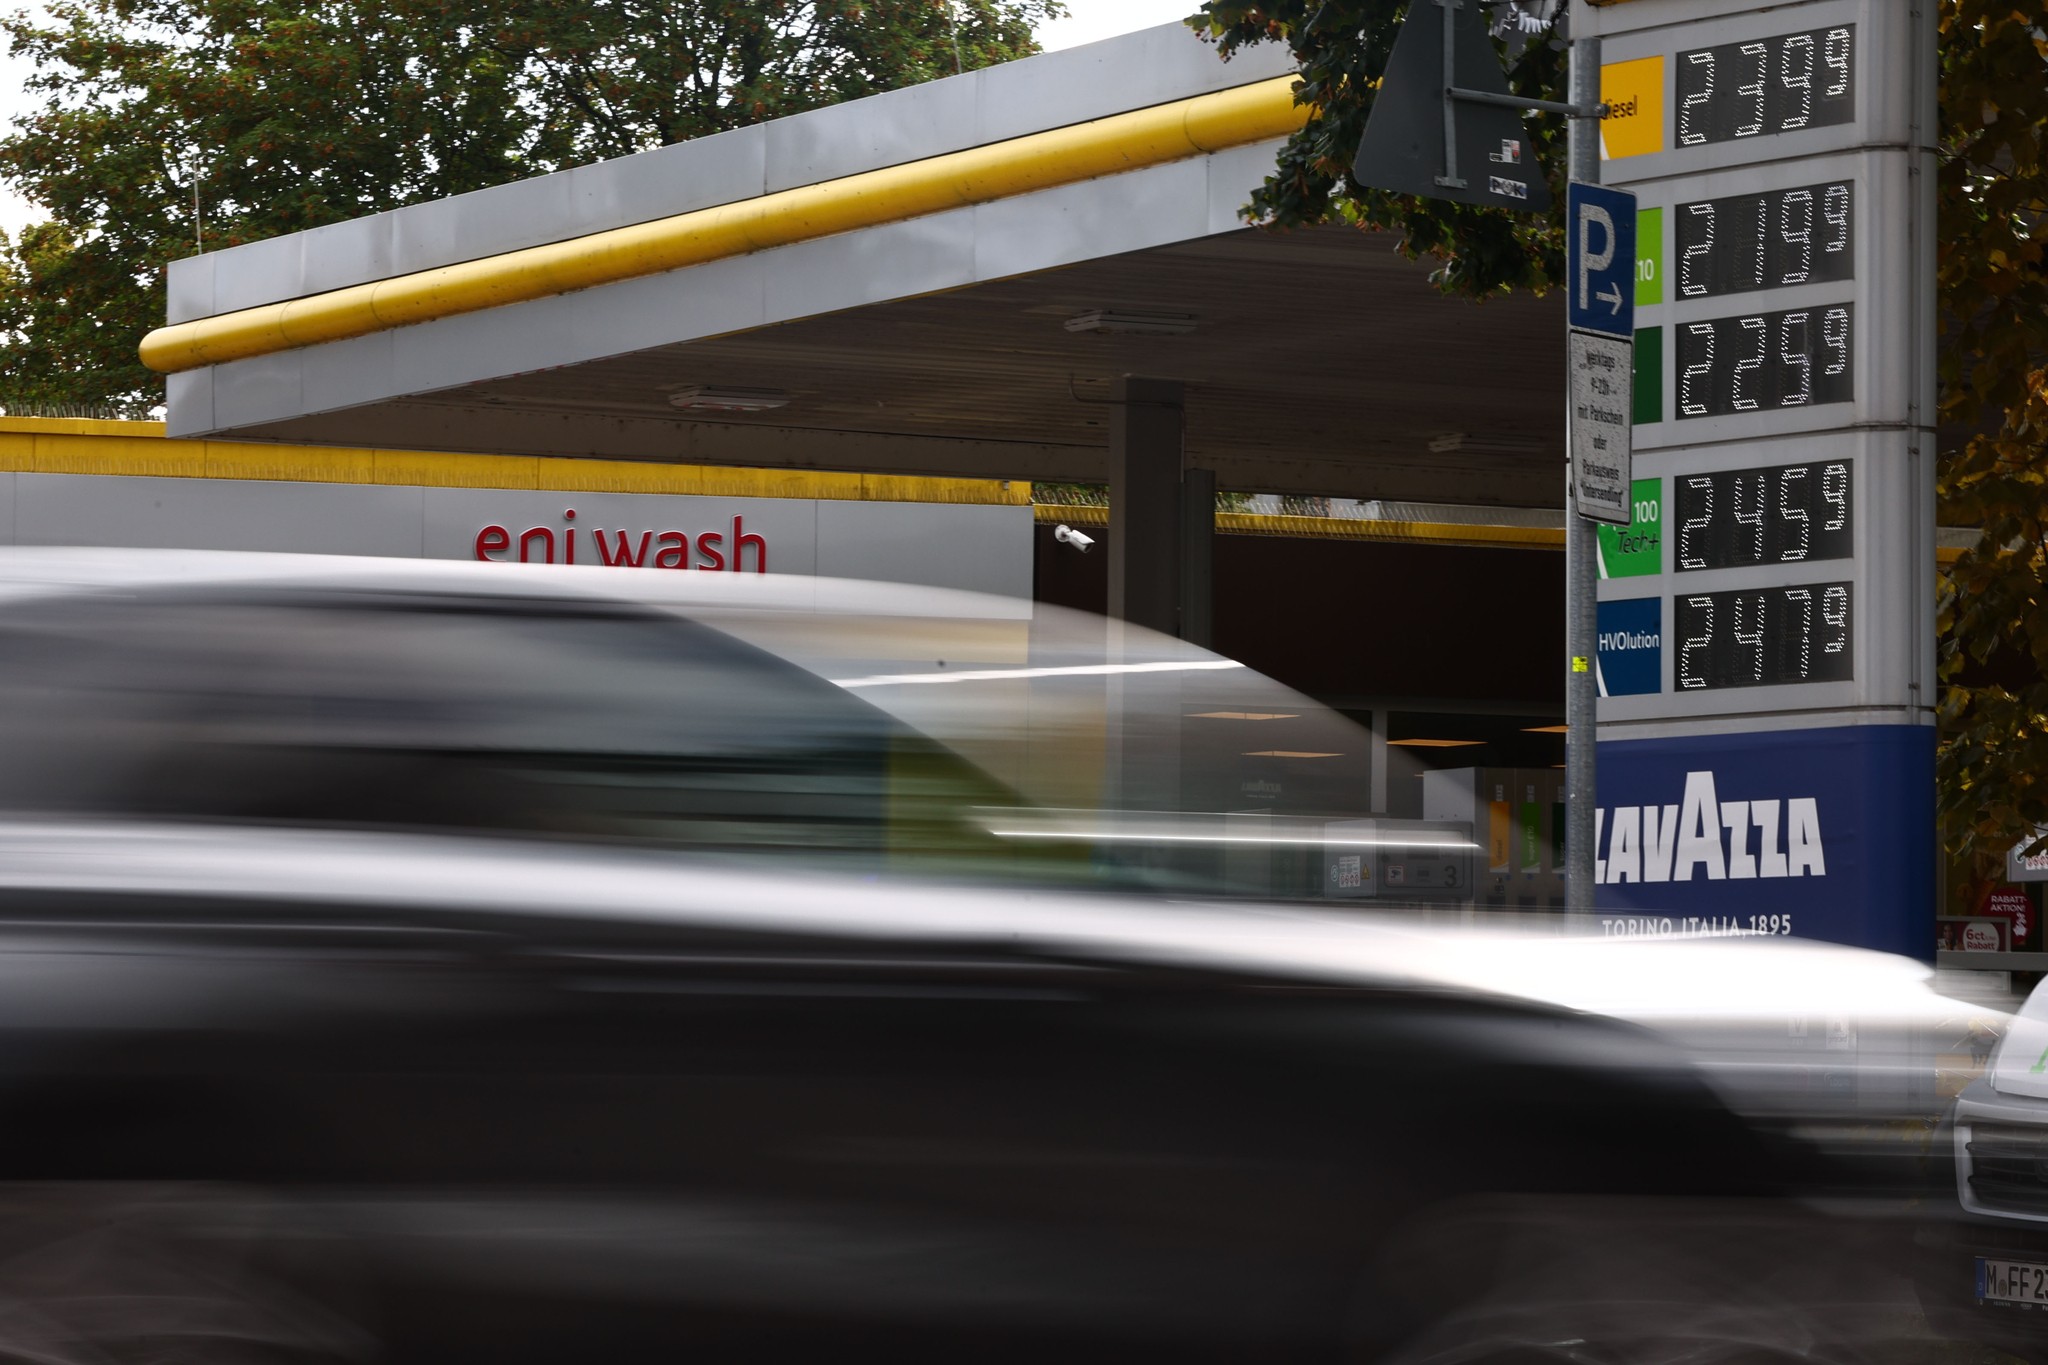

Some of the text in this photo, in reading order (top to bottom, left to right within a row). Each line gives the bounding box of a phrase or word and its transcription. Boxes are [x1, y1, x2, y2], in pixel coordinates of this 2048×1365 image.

[1579, 203, 1615, 310] P
[1635, 257, 1654, 282] 10
[1590, 404, 1623, 425] Parkschein
[1583, 459, 1619, 480] Parkausweis
[1635, 500, 1658, 523] 100
[474, 508, 766, 574] eni wash
[1599, 630, 1660, 652] HVOlution
[1444, 865, 1457, 888] 3
[1749, 913, 1791, 936] 1895
[1967, 941, 1996, 951] Rabatt
